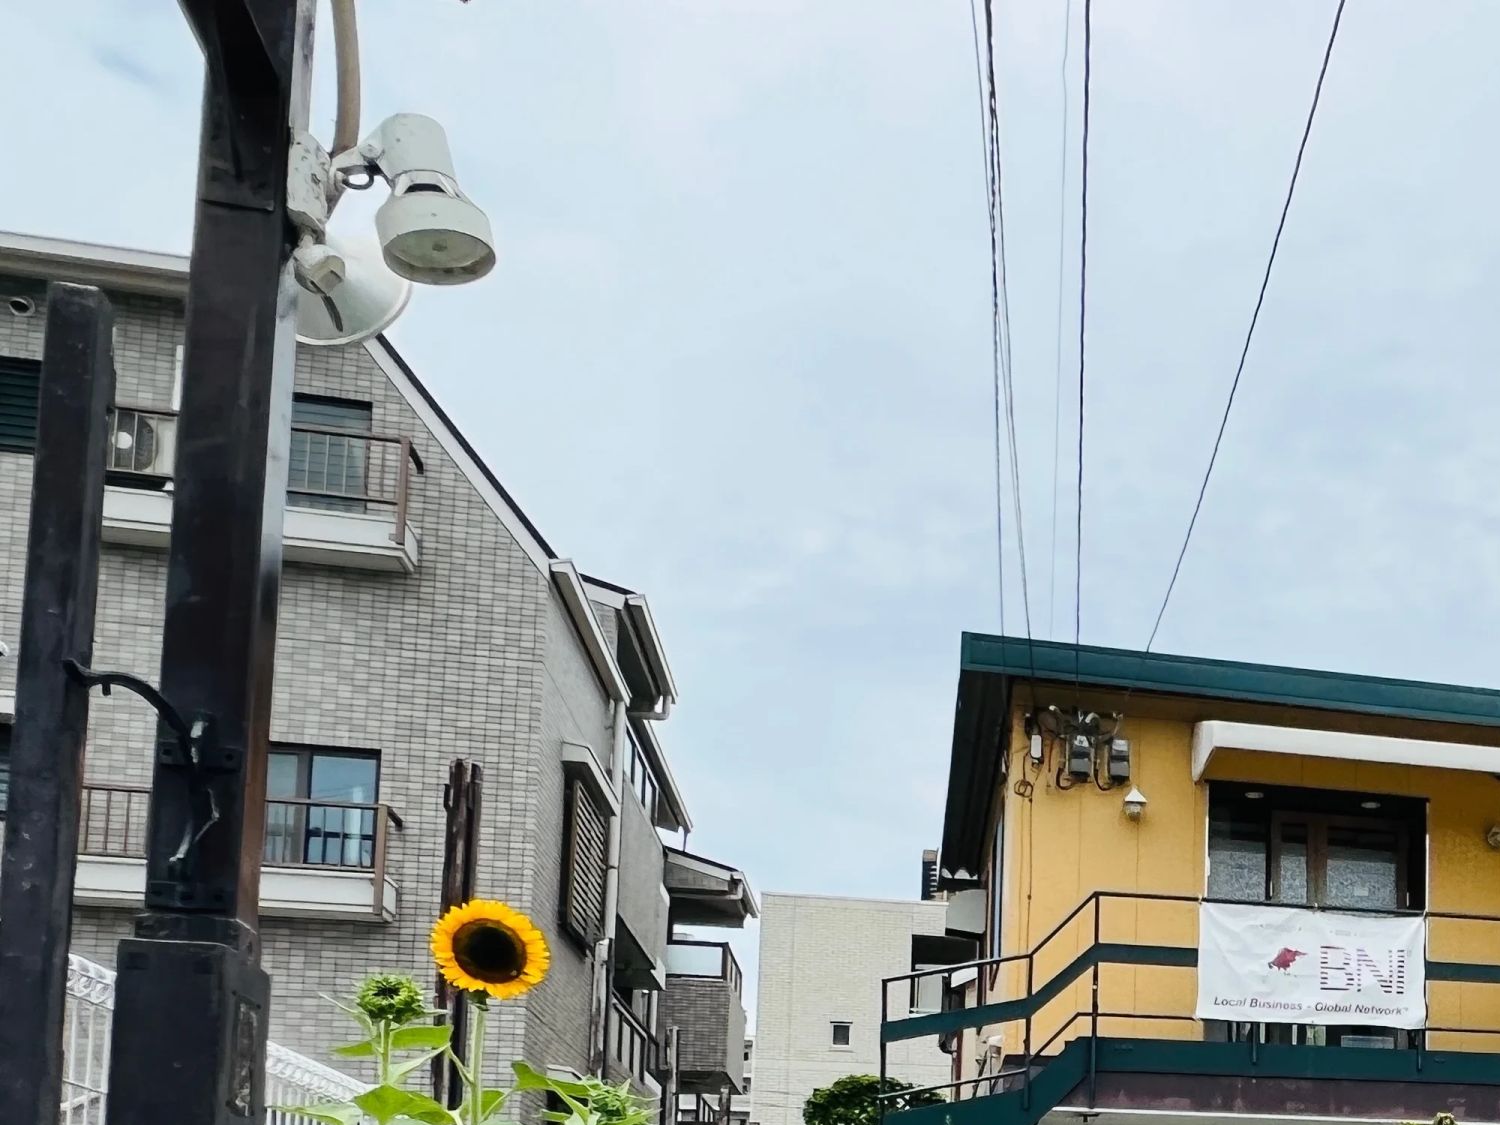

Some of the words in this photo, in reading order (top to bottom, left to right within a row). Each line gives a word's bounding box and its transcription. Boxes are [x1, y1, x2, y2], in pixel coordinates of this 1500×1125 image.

[1320, 945, 1405, 995] BNI
[1213, 996, 1246, 1008] Local
[1249, 997, 1303, 1012] Business
[1314, 1001, 1352, 1014] Global
